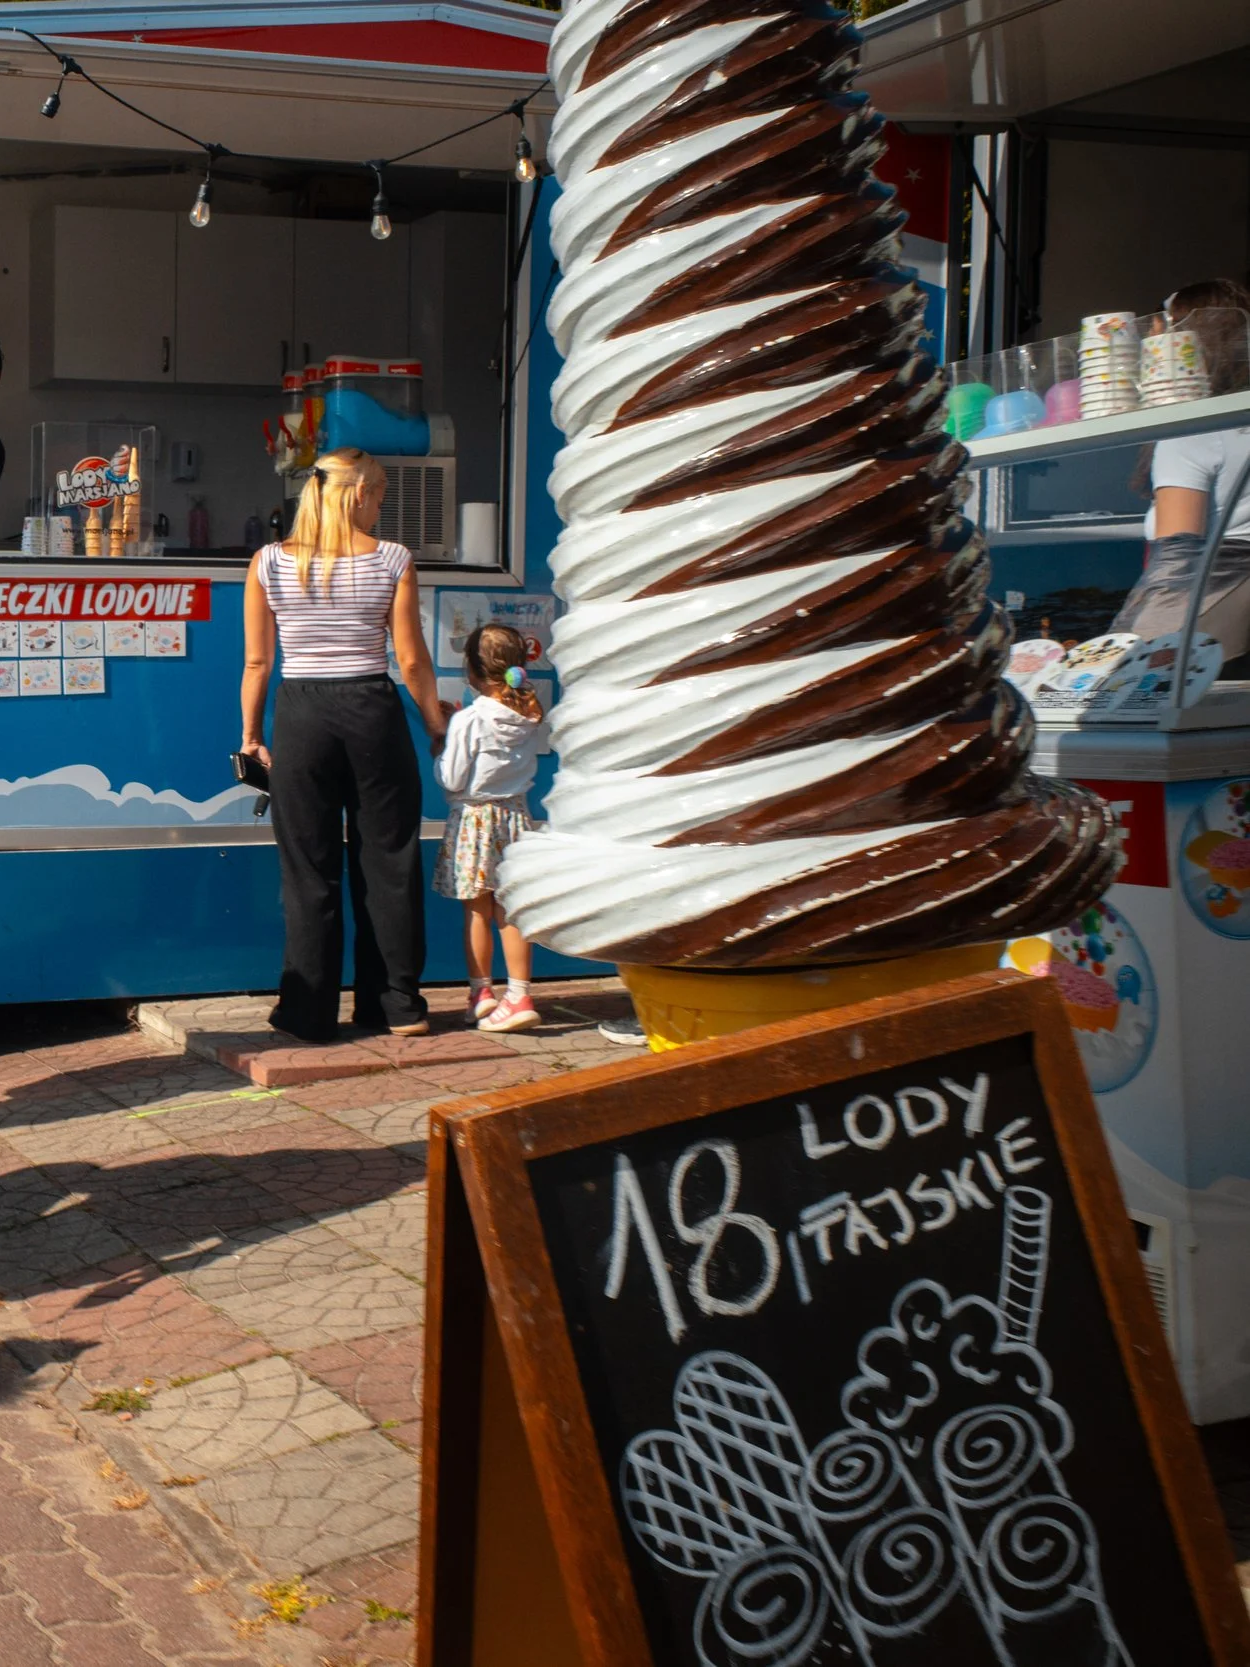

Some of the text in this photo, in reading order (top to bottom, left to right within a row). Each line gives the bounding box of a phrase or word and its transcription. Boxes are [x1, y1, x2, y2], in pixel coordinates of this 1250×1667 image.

[58, 466, 110, 492] LODY
[59, 480, 140, 506] MARSJANO
[80, 582, 196, 616] LODOWE
[797, 1073, 989, 1160] LODY
[800, 1117, 1045, 1265] TAJSKIE
